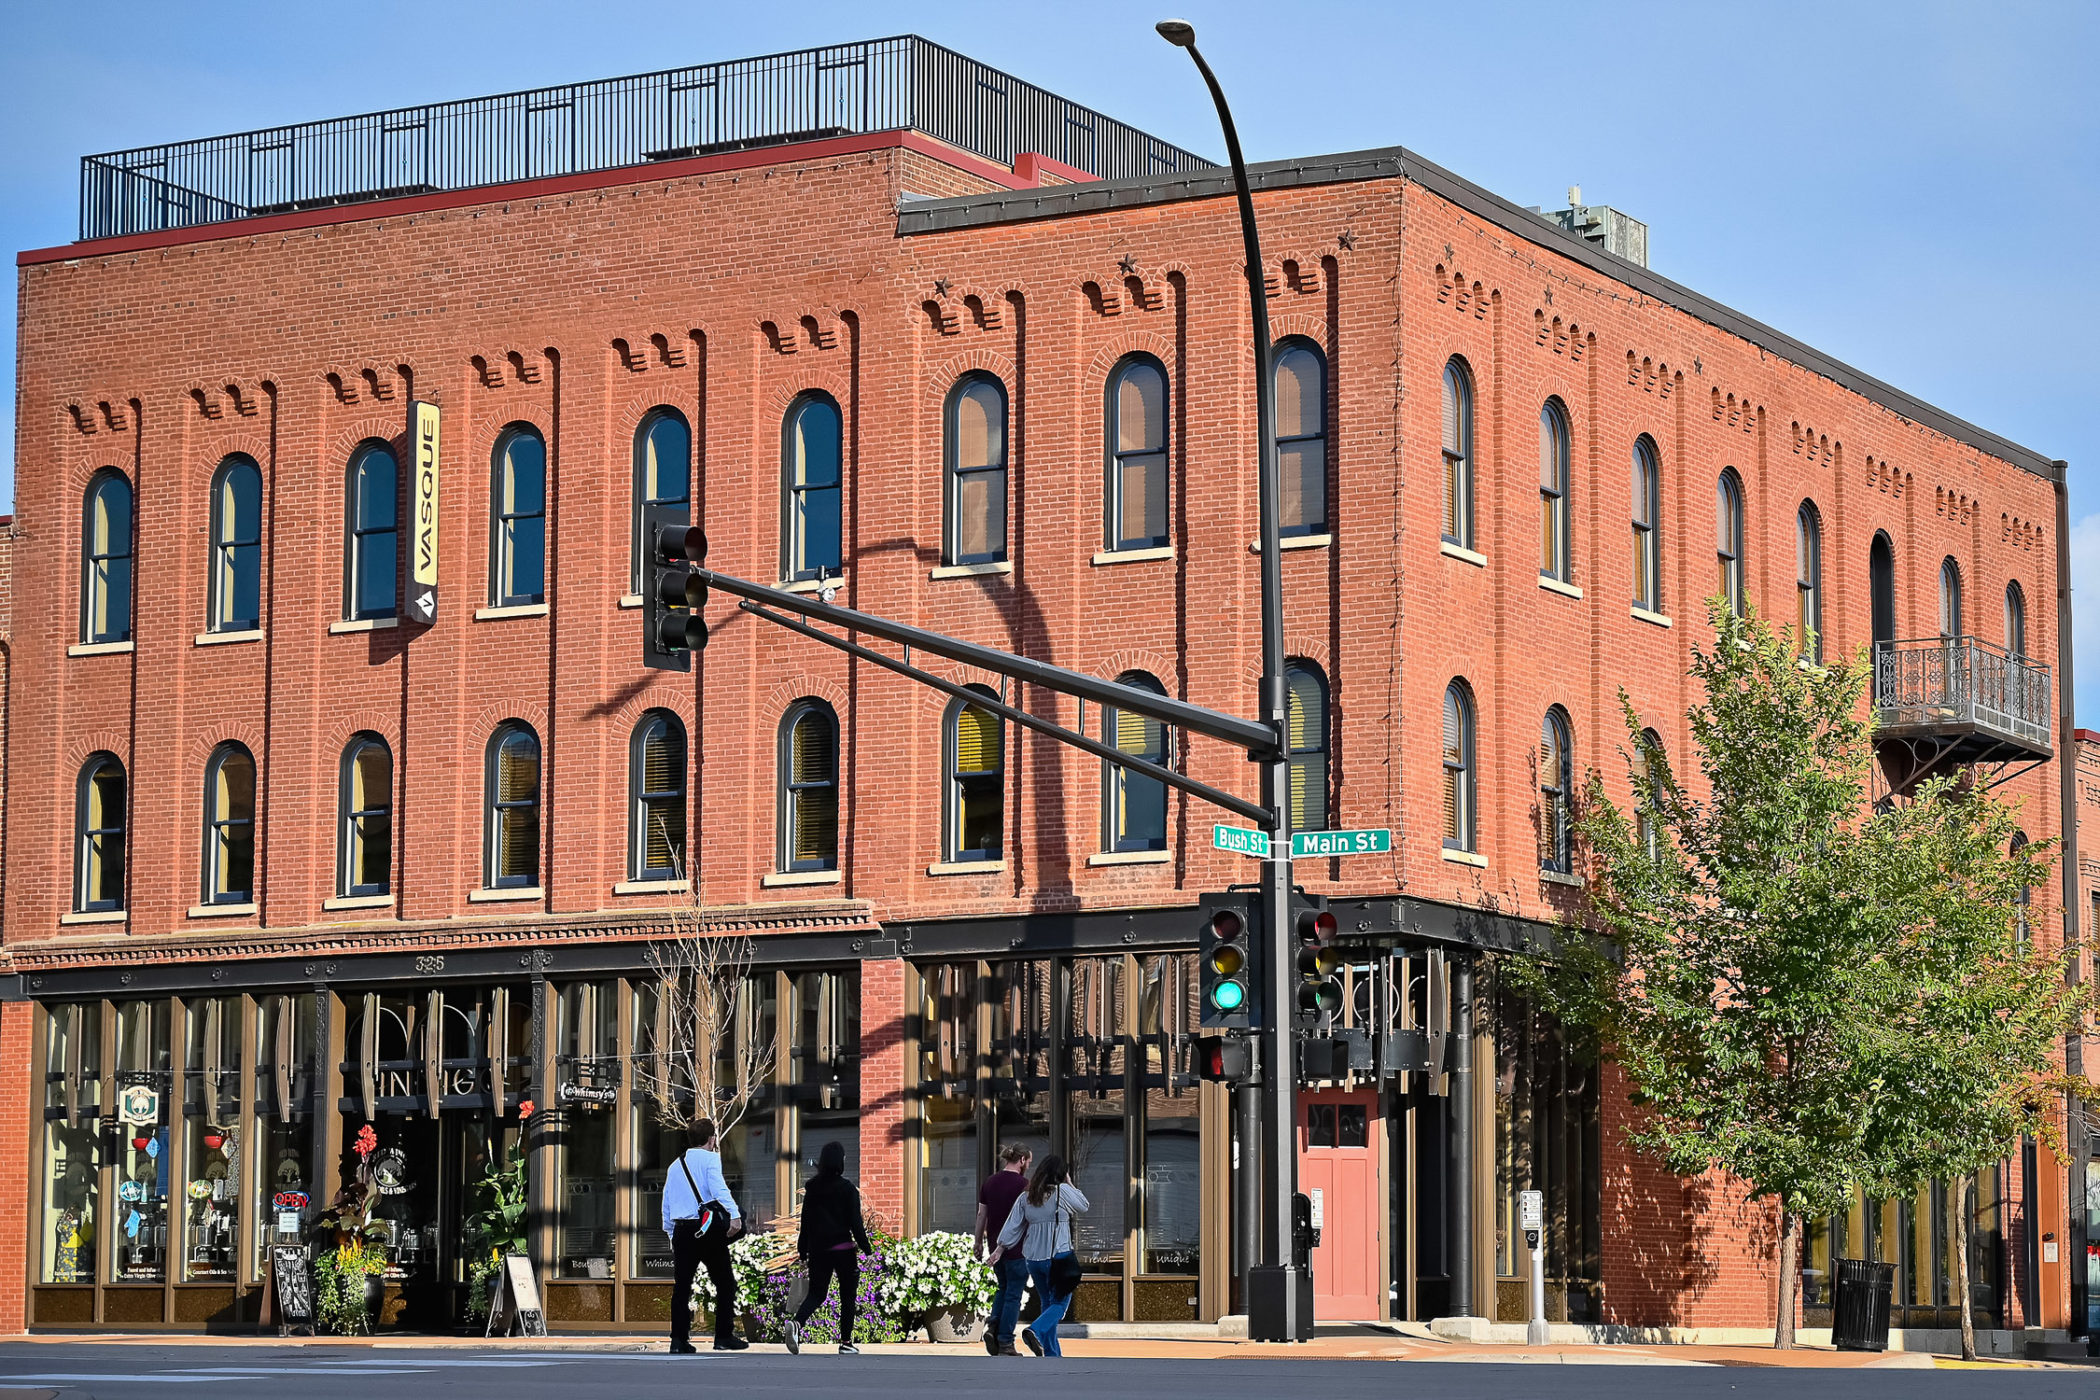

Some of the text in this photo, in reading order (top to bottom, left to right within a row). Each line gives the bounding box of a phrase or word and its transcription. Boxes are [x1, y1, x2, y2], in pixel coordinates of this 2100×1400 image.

[420, 418, 435, 571] VASQUE
[1219, 828, 1263, 851] Bush St
[1303, 832, 1378, 853] Main St
[415, 955, 445, 971] 325
[274, 1193, 307, 1208] OPEN
[1156, 1253, 1190, 1266] Unique
